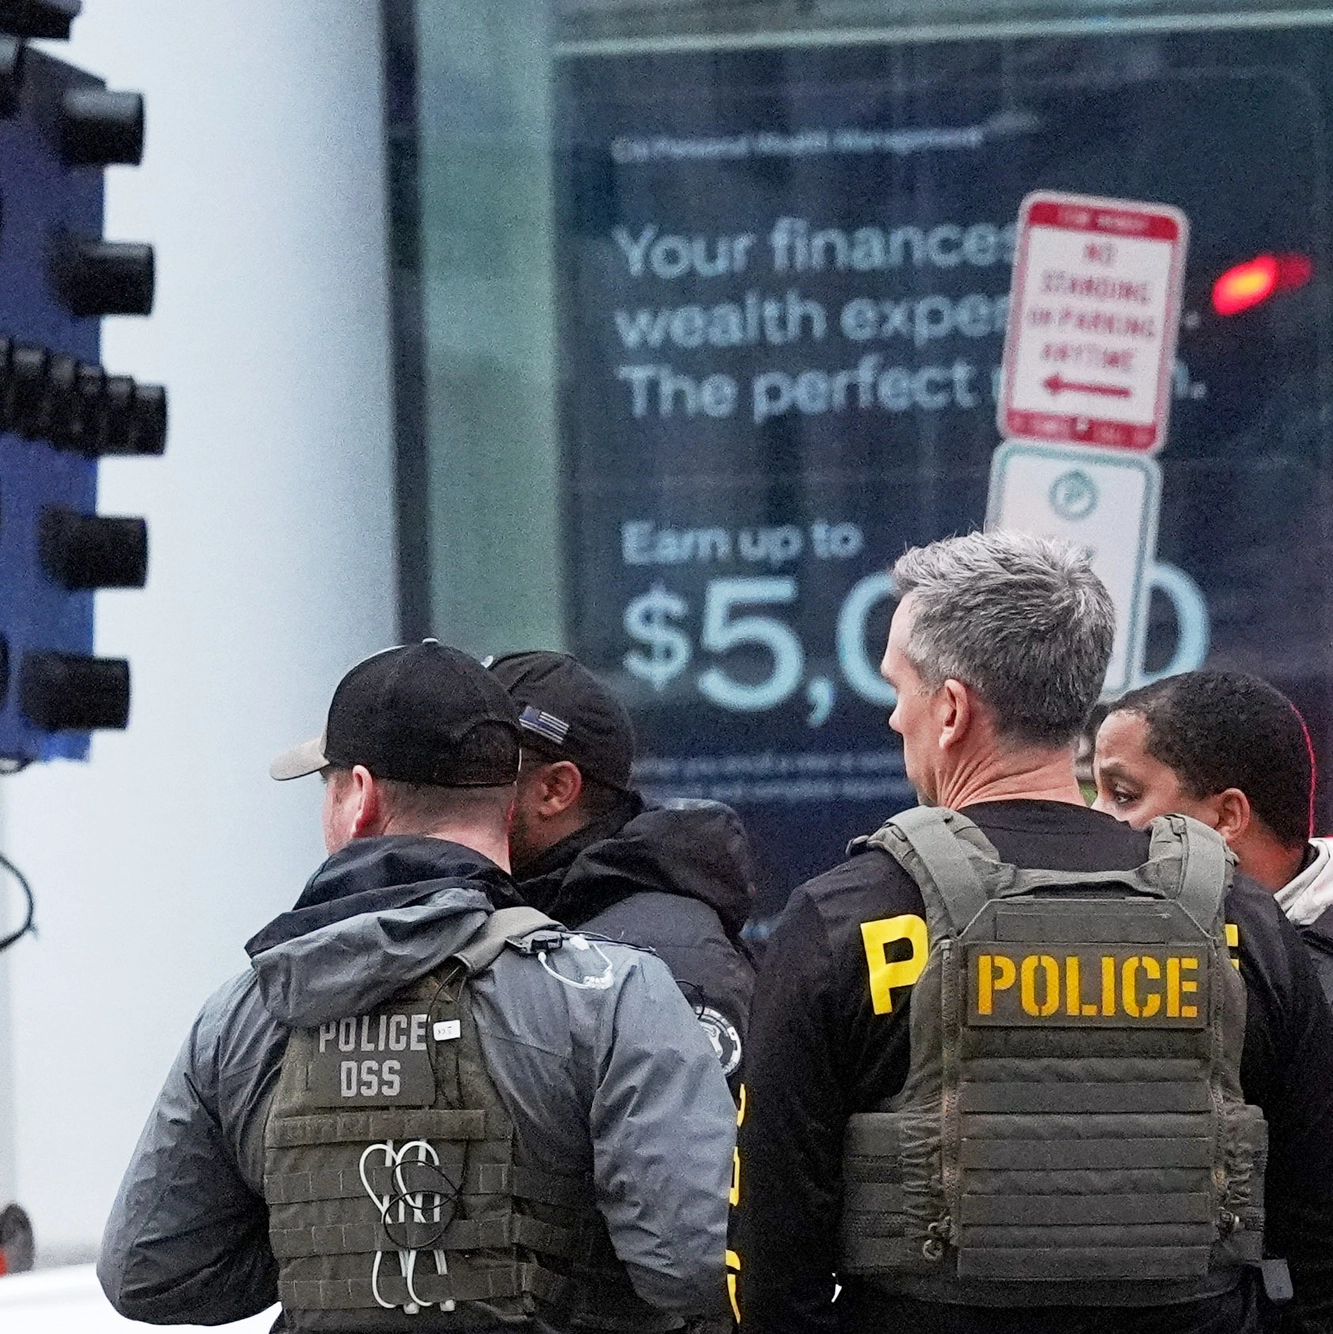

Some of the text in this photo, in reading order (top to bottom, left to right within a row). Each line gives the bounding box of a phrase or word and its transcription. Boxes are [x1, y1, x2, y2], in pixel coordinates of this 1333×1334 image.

[612, 224, 755, 278] Your
[613, 288, 827, 348] wealth
[615, 362, 738, 418] The
[753, 354, 982, 424] perfect
[621, 520, 864, 568] Earn up to
[977, 954, 1199, 1018] POLICE
[319, 1014, 430, 1053] POLICE
[341, 1060, 401, 1097] DSS
